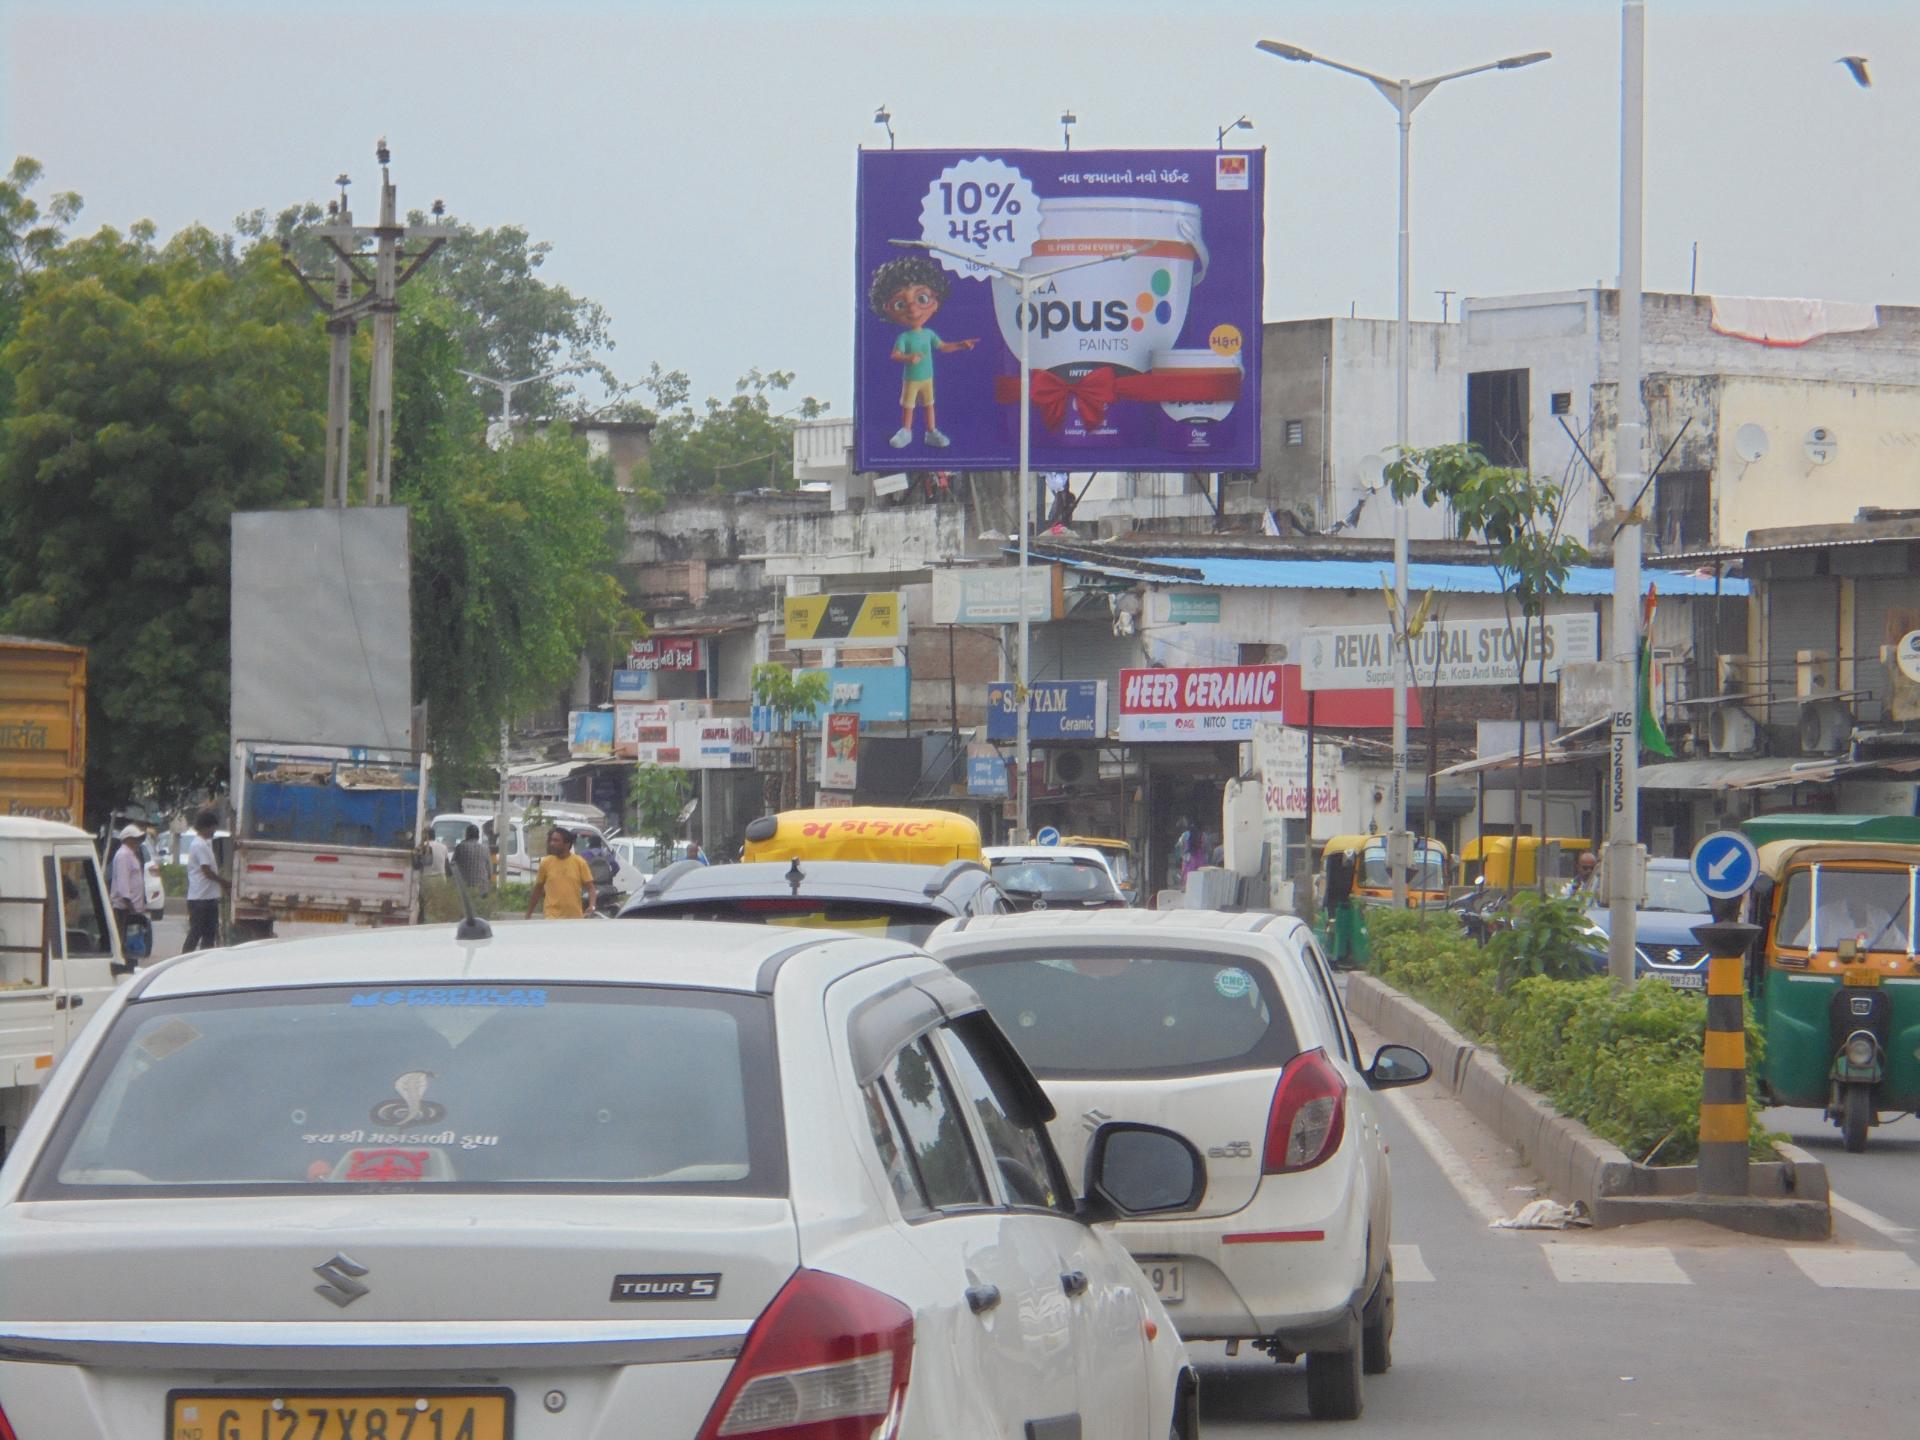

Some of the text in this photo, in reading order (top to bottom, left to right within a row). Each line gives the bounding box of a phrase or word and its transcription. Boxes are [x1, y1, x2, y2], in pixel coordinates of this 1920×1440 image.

[1058, 173, 1080, 184] નવા
[1083, 169, 1133, 184] જમાનાનો
[1136, 169, 1158, 184] નવો
[939, 182, 1021, 215] 10%
[948, 220, 1015, 250] મફત
[1079, 339, 1129, 351] PAINTS
[1335, 633, 1382, 668] REVA
[1387, 628, 1473, 666] NTURAL
[627, 654, 660, 670] Traders
[1451, 666, 1471, 680] Kota
[1472, 665, 1490, 679] And
[1125, 670, 1277, 710] HEER CERAMIC
[1060, 715, 1094, 731] Ceramic
[1203, 716, 1227, 729] NITCO
[1232, 718, 1253, 730] CER
[338, 1130, 364, 1144] શ્રી
[619, 1279, 715, 1296] TOUR S
